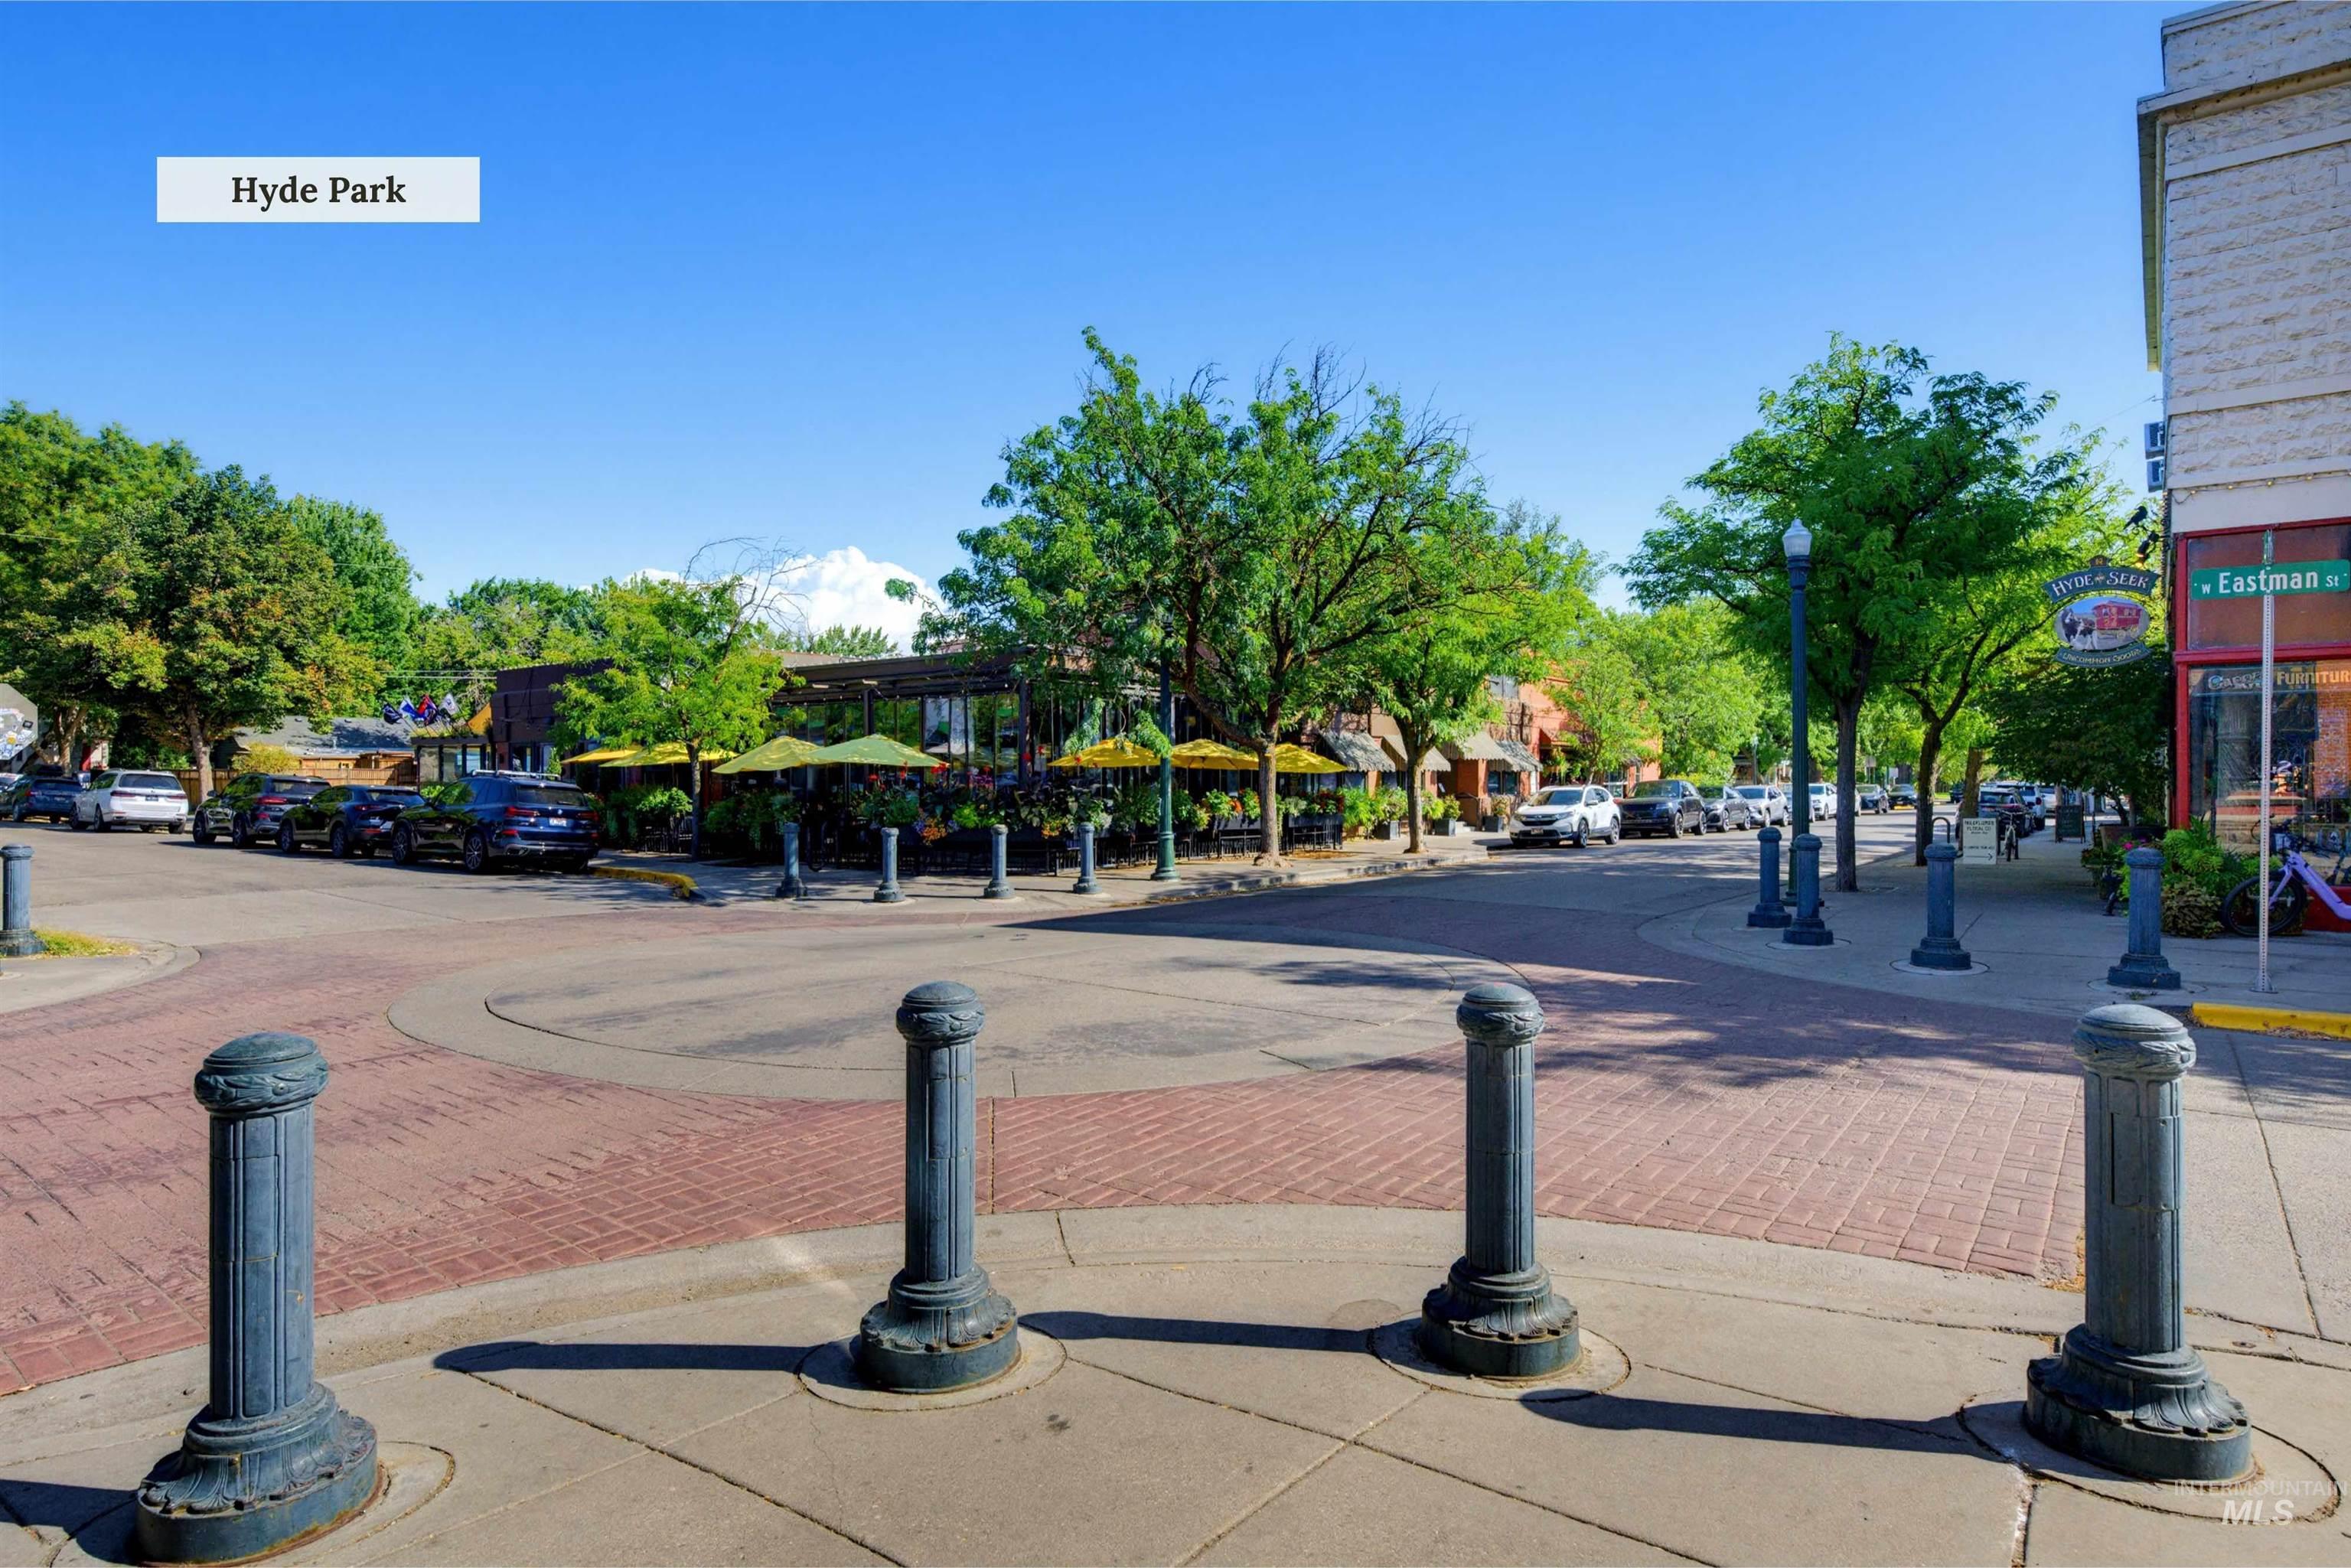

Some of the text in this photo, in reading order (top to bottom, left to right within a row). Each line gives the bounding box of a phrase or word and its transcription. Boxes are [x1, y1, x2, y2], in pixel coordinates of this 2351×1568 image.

[2052, 571, 2150, 596] HYDE SEEK
[2202, 569, 2340, 595] W Eastman St
